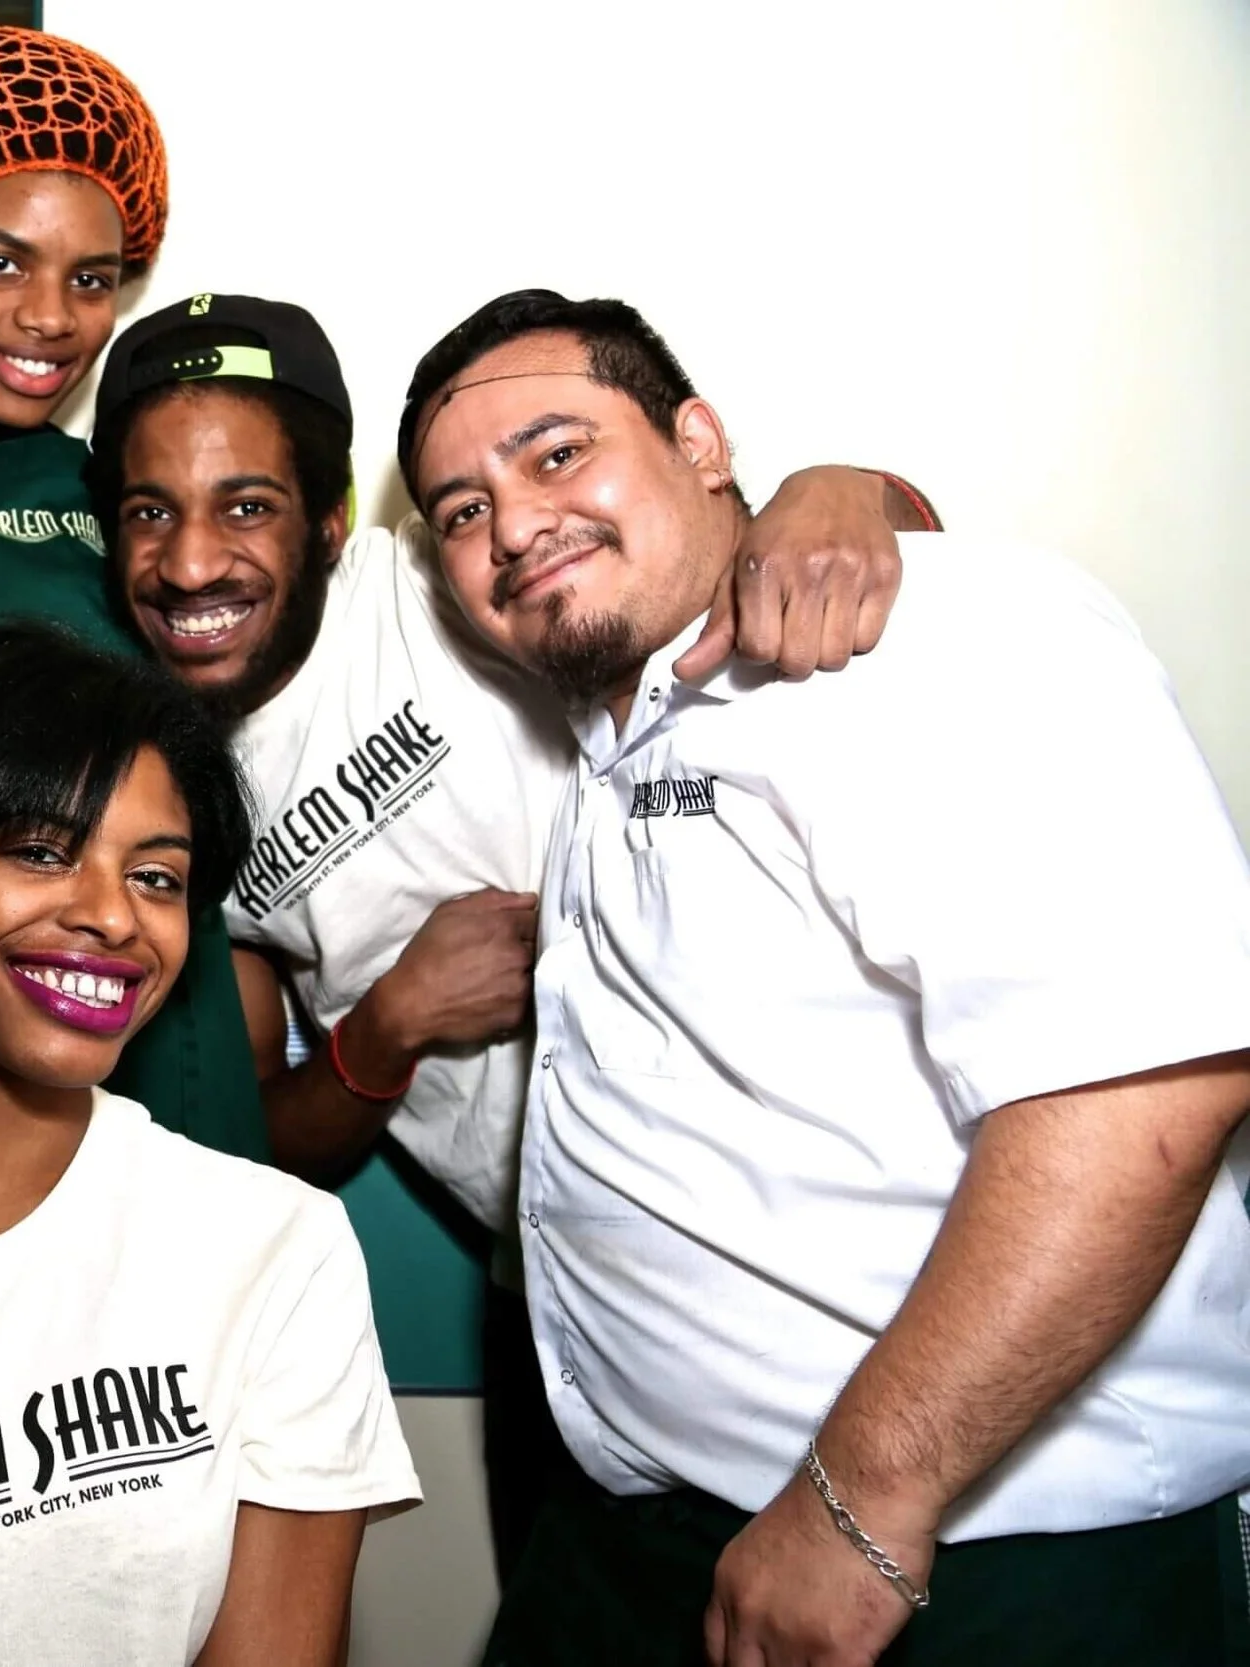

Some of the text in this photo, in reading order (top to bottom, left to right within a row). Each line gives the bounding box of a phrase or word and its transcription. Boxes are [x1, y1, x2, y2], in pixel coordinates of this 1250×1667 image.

[234, 699, 444, 921] HARLEM SHAKE
[332, 850, 352, 867] NEW
[351, 829, 376, 851] YORK
[391, 801, 411, 820] NEW
[411, 779, 436, 803] YORK
[23, 1364, 209, 1495] SHAKE
[40, 1493, 76, 1516] CITY,
[79, 1482, 114, 1505] NEW
[116, 1474, 163, 1493] YORK
